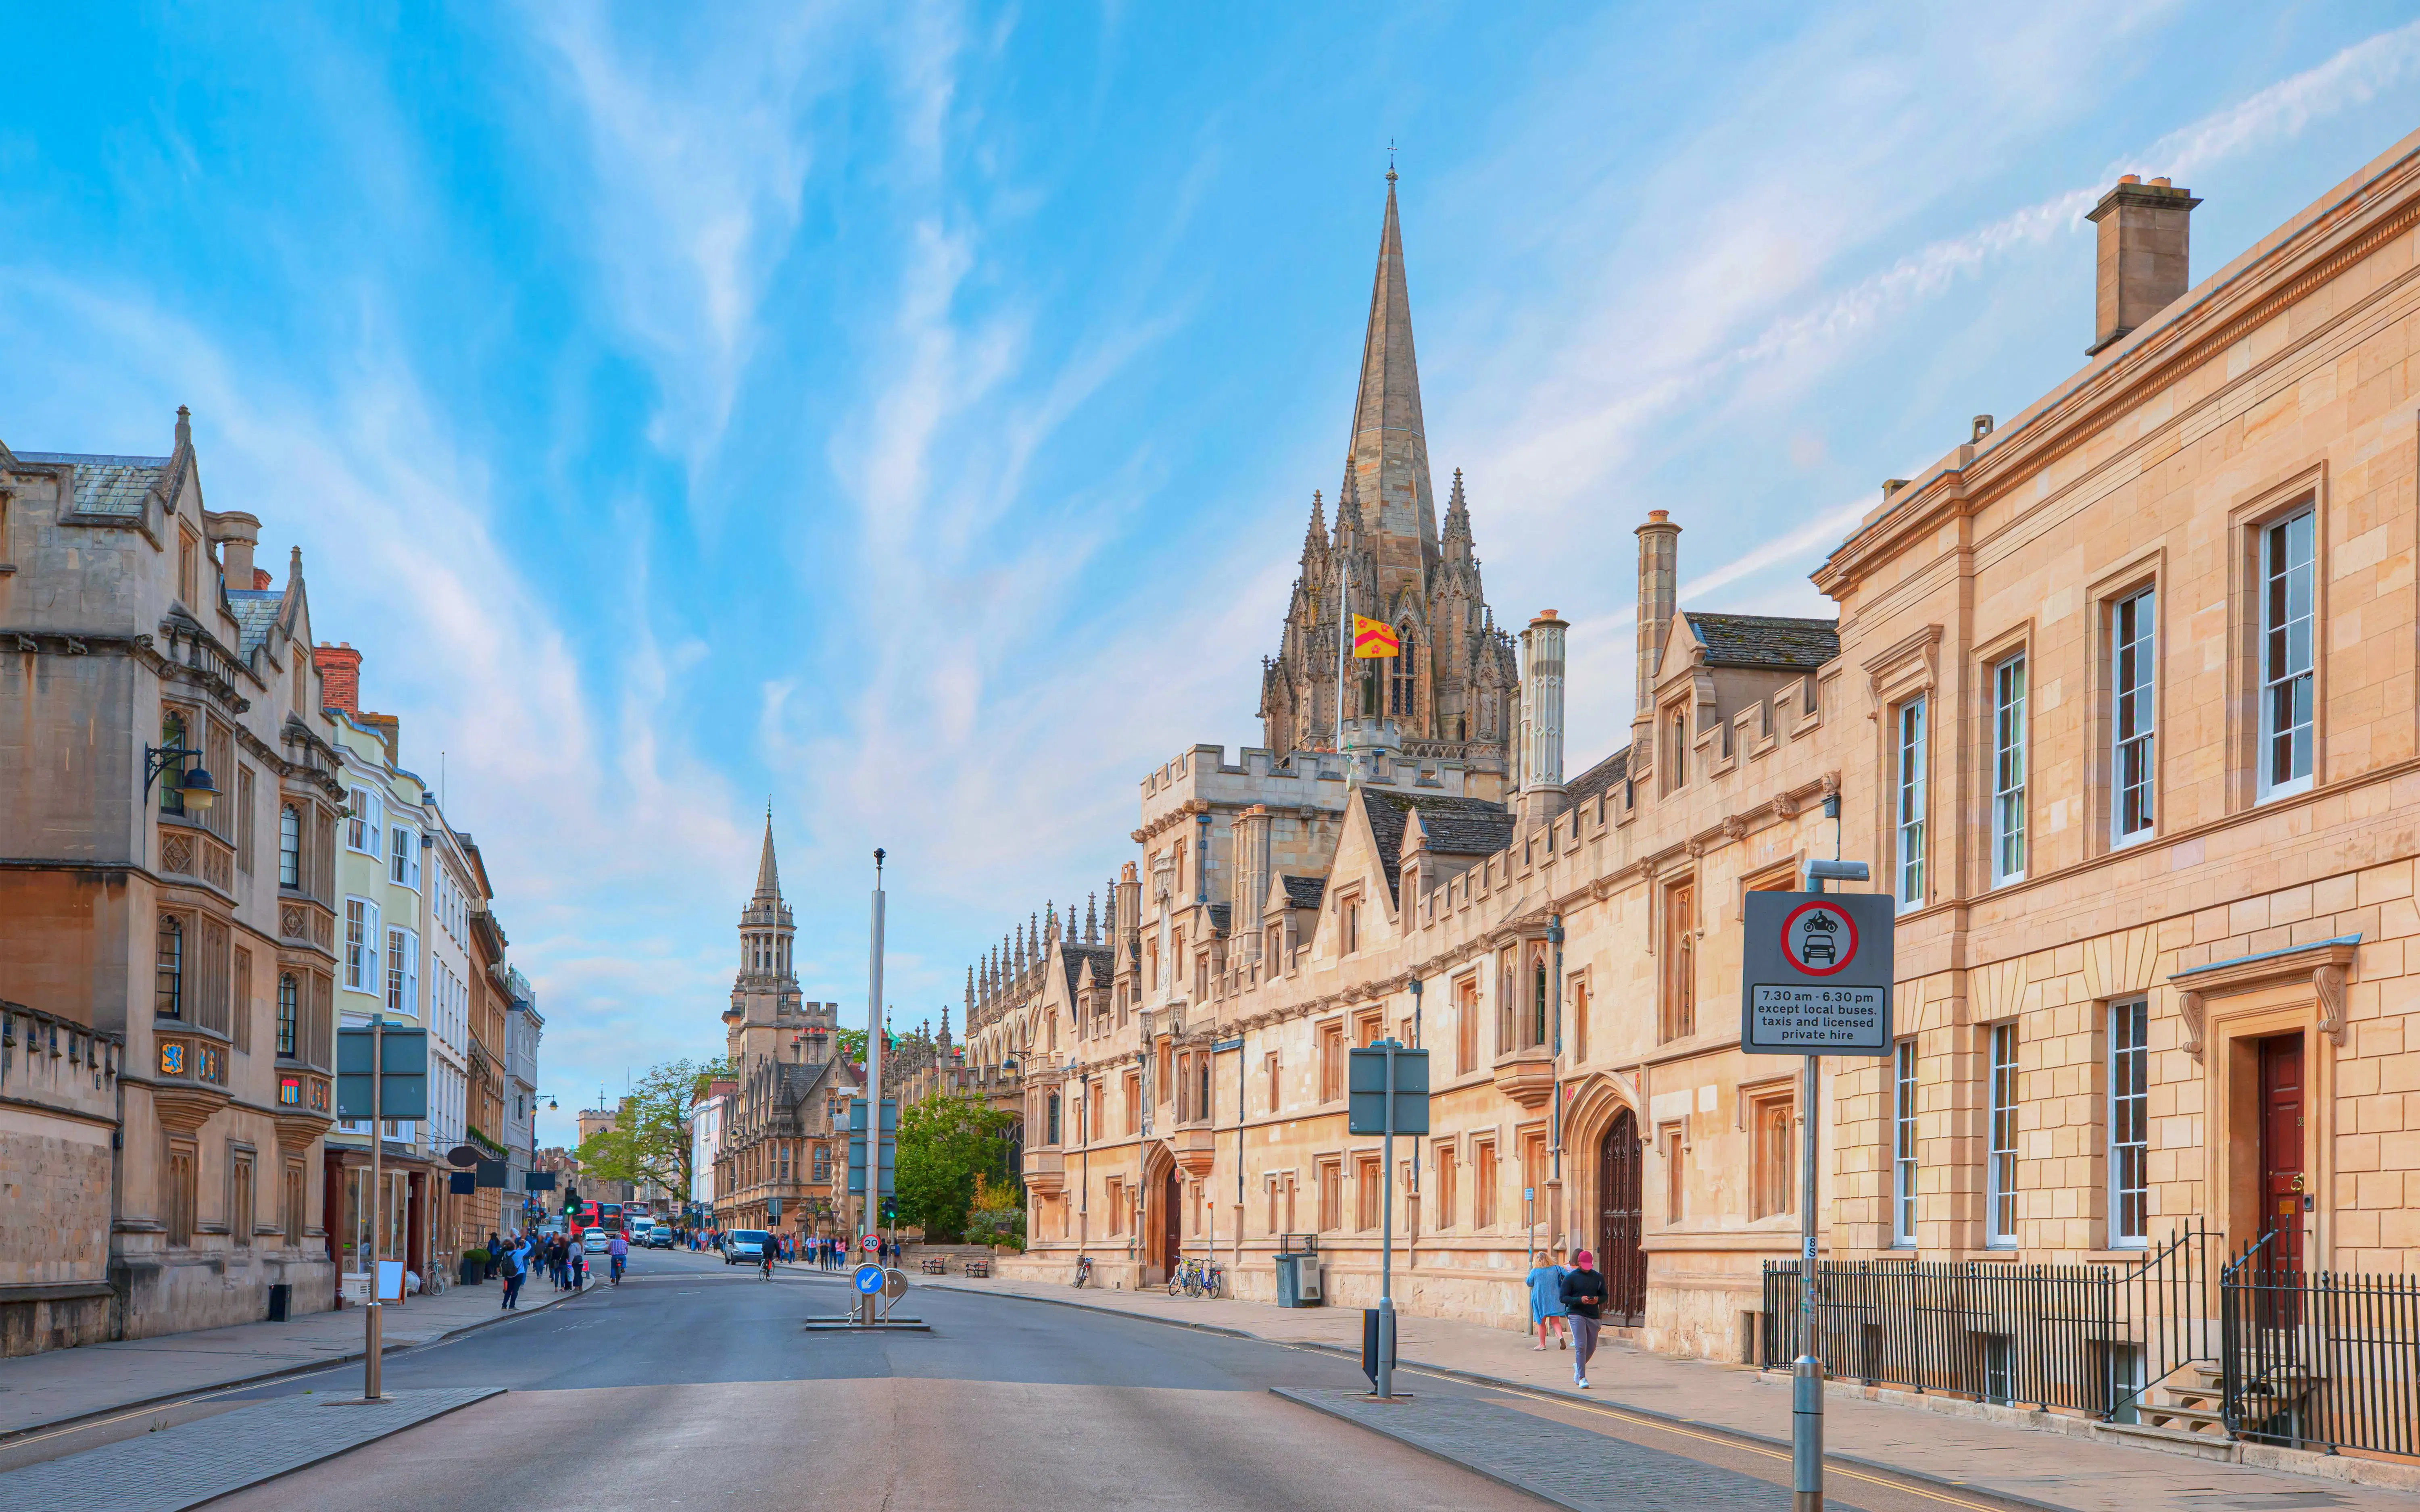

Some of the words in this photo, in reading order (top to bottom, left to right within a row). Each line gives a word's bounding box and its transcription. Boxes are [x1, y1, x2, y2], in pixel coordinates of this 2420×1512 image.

[1763, 991, 1791, 1001] 7.30
[1823, 992, 1852, 1002] 6.30
[1855, 995, 1873, 1004] pm
[1758, 1004, 1799, 1015] except
[1804, 1004, 1834, 1014] local
[1762, 1016, 1792, 1026] taxis
[1796, 1017, 1818, 1026] and
[1823, 1017, 1873, 1027] licensed
[1782, 1029, 1825, 1040] private
[1830, 1030, 1853, 1039] hire
[2297, 1117, 2304, 1126] 32
